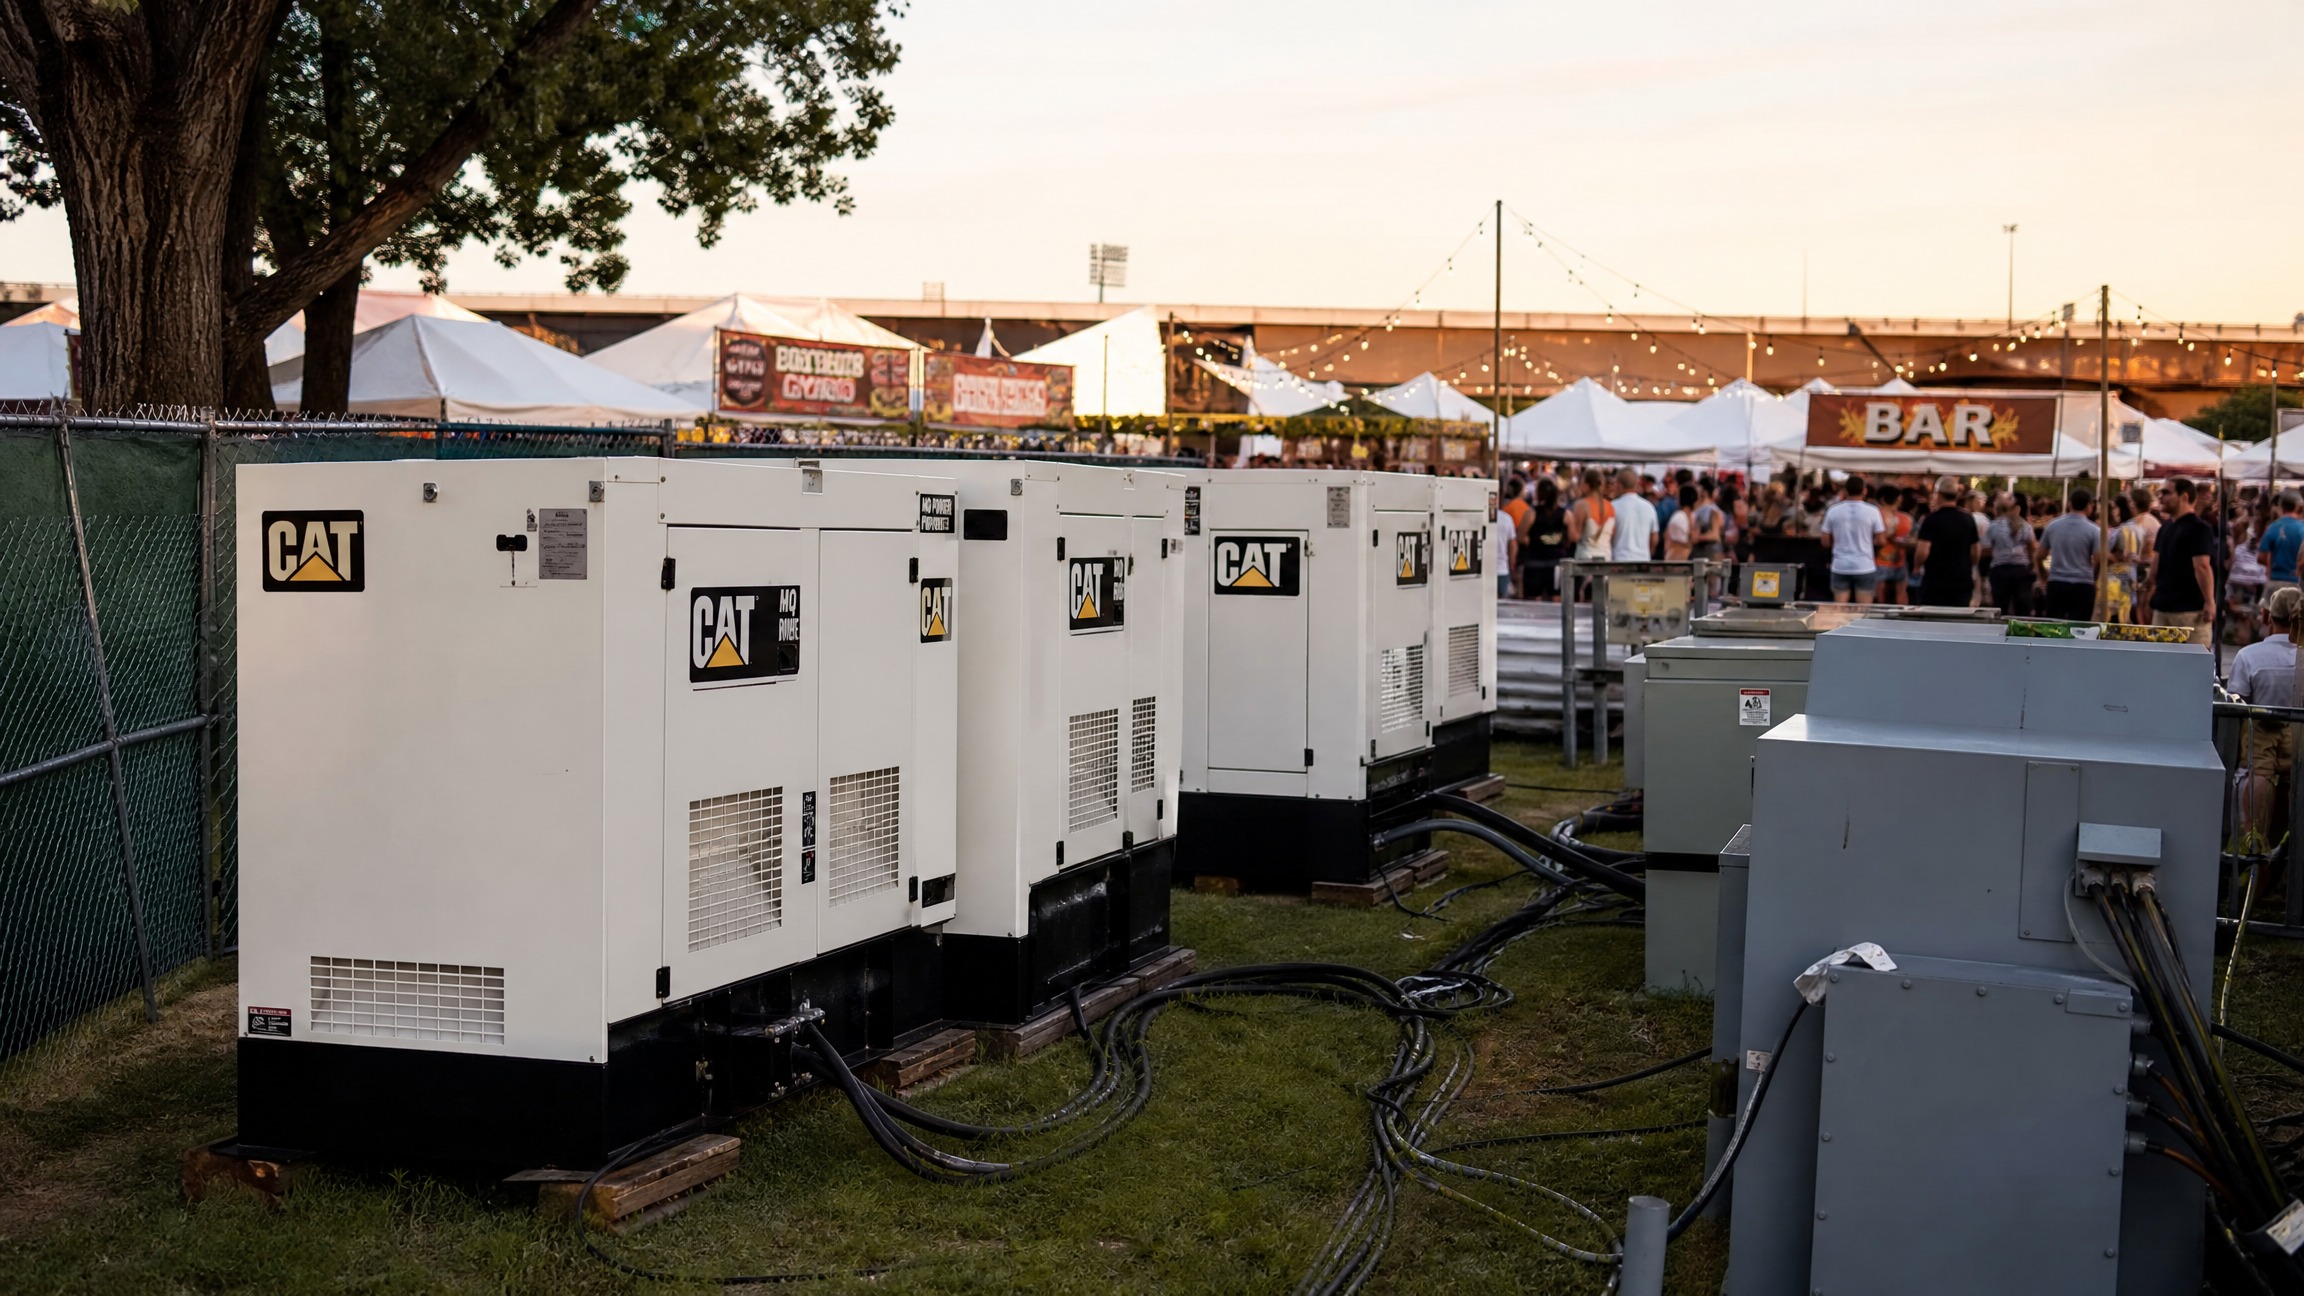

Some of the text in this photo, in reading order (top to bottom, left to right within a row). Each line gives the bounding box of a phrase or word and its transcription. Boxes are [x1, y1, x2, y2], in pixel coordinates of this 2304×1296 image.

[1864, 402, 1994, 446] BAR
[268, 520, 358, 582] CAT
[1217, 541, 1287, 588] CAT
[1398, 535, 1417, 579] CAT
[1449, 530, 1473, 571] CAT
[779, 588, 797, 617] MQ
[921, 587, 952, 637] CAT
[1071, 563, 1104, 620] CAT
[693, 595, 755, 669] CAT
